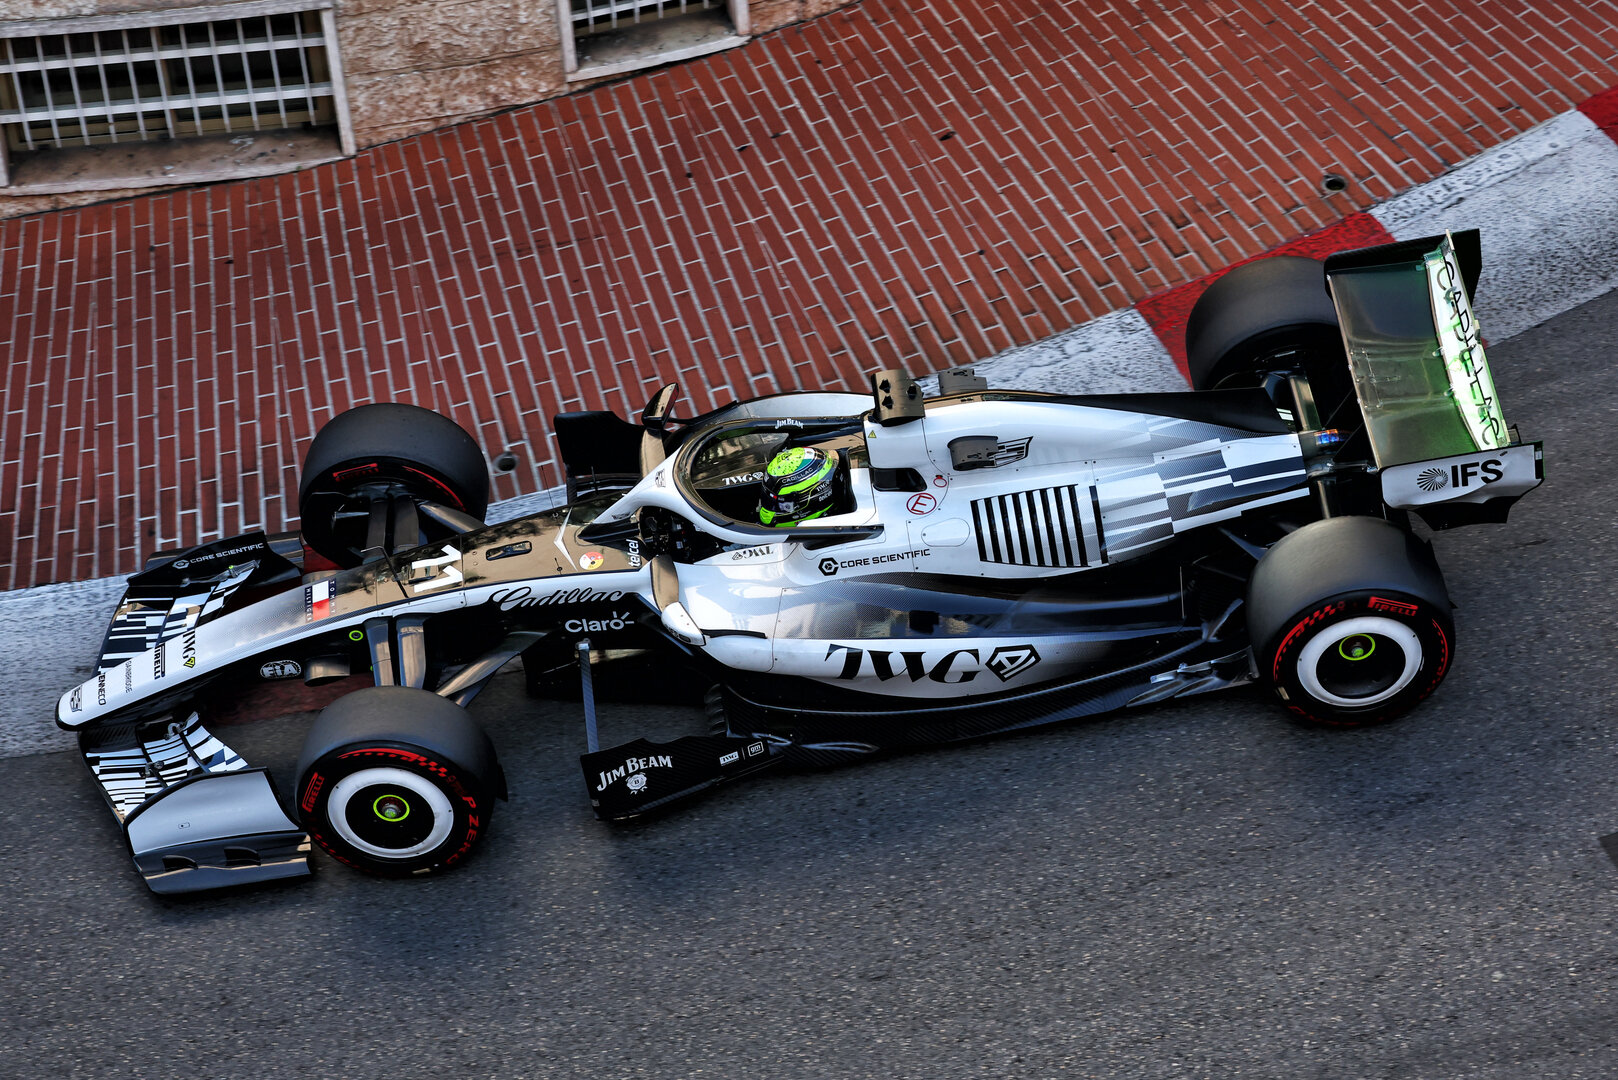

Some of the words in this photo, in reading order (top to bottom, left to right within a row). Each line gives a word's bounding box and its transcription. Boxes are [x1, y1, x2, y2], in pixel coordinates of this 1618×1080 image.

[775, 420, 786, 429] JIM
[787, 418, 804, 429] BEAM
[722, 473, 753, 486] TWG
[782, 467, 814, 484] CADILLAC
[1451, 459, 1503, 488] IFS
[911, 494, 932, 514] E
[190, 554, 215, 564] CORE
[217, 542, 265, 558] SCIENTIFIC
[628, 539, 640, 568] telcel
[840, 557, 870, 569] CORE
[872, 549, 931, 565] SCIENTIFIC
[411, 544, 464, 593] 11
[489, 586, 625, 612] Cadillac
[1367, 596, 1419, 616] PIRELLI
[565, 617, 625, 633] Claro
[824, 643, 981, 684] TWG
[596, 766, 626, 791] JIM
[626, 755, 673, 774] BEAM
[302, 772, 325, 813] PIRELLI
[462, 795, 477, 809] P
